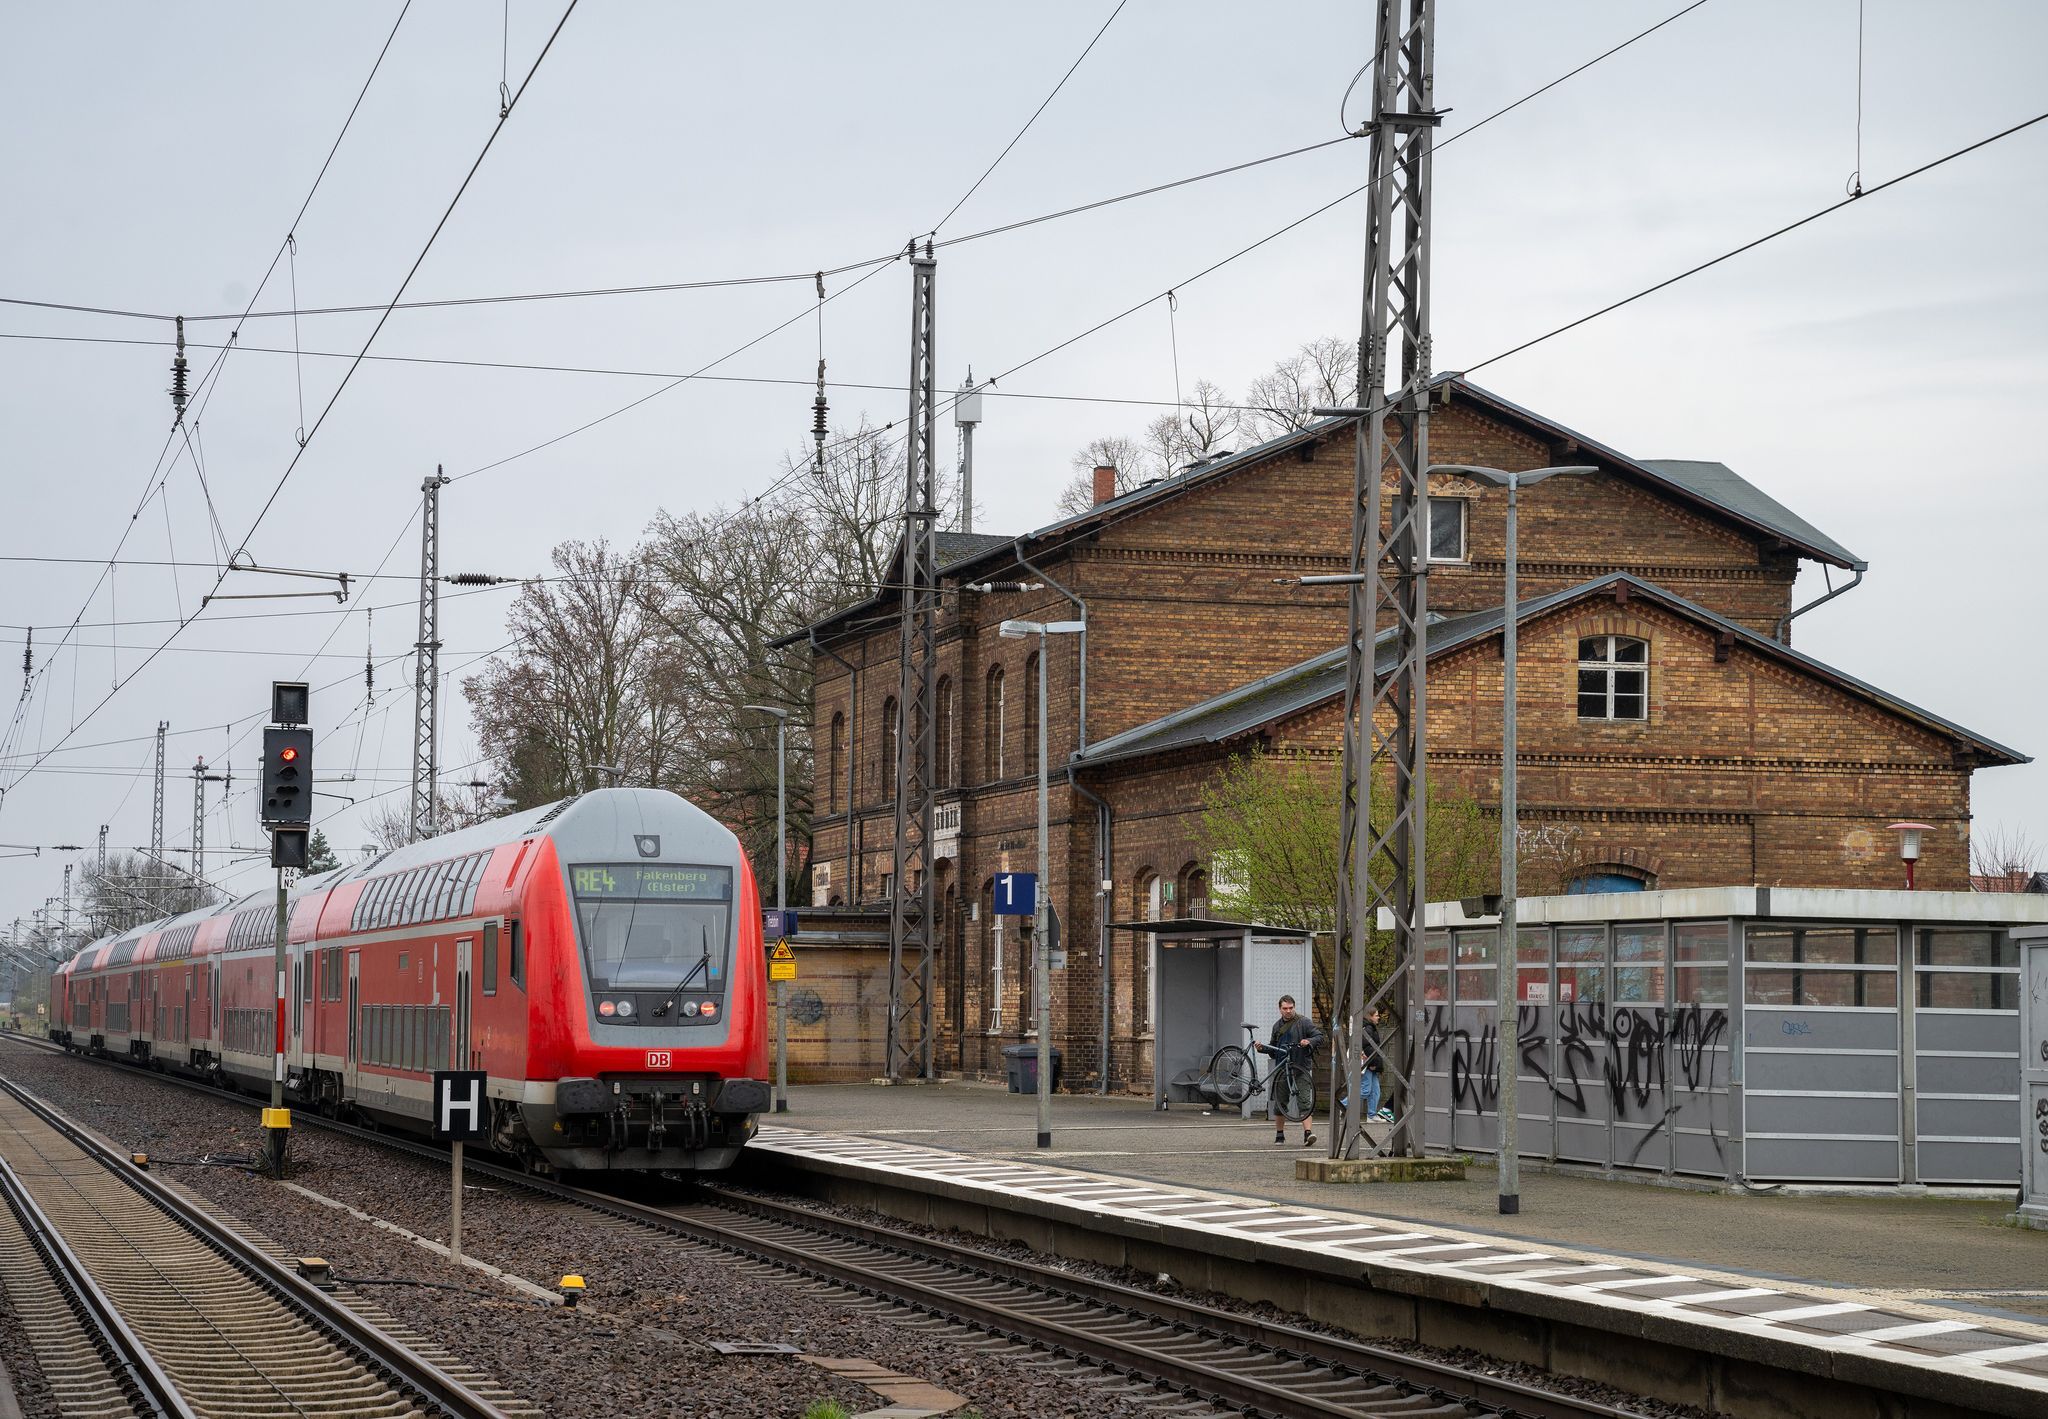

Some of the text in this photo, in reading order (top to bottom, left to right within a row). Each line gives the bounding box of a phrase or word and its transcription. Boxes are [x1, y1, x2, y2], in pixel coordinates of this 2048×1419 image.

[284, 868, 295, 877] 26
[635, 870, 707, 882] Falkenberg
[284, 879, 295, 888] N2
[575, 868, 616, 892] RE4
[647, 882, 696, 892] (Elster)
[1000, 874, 1013, 905] 1
[649, 1053, 669, 1066] DB
[441, 1079, 479, 1131] H
